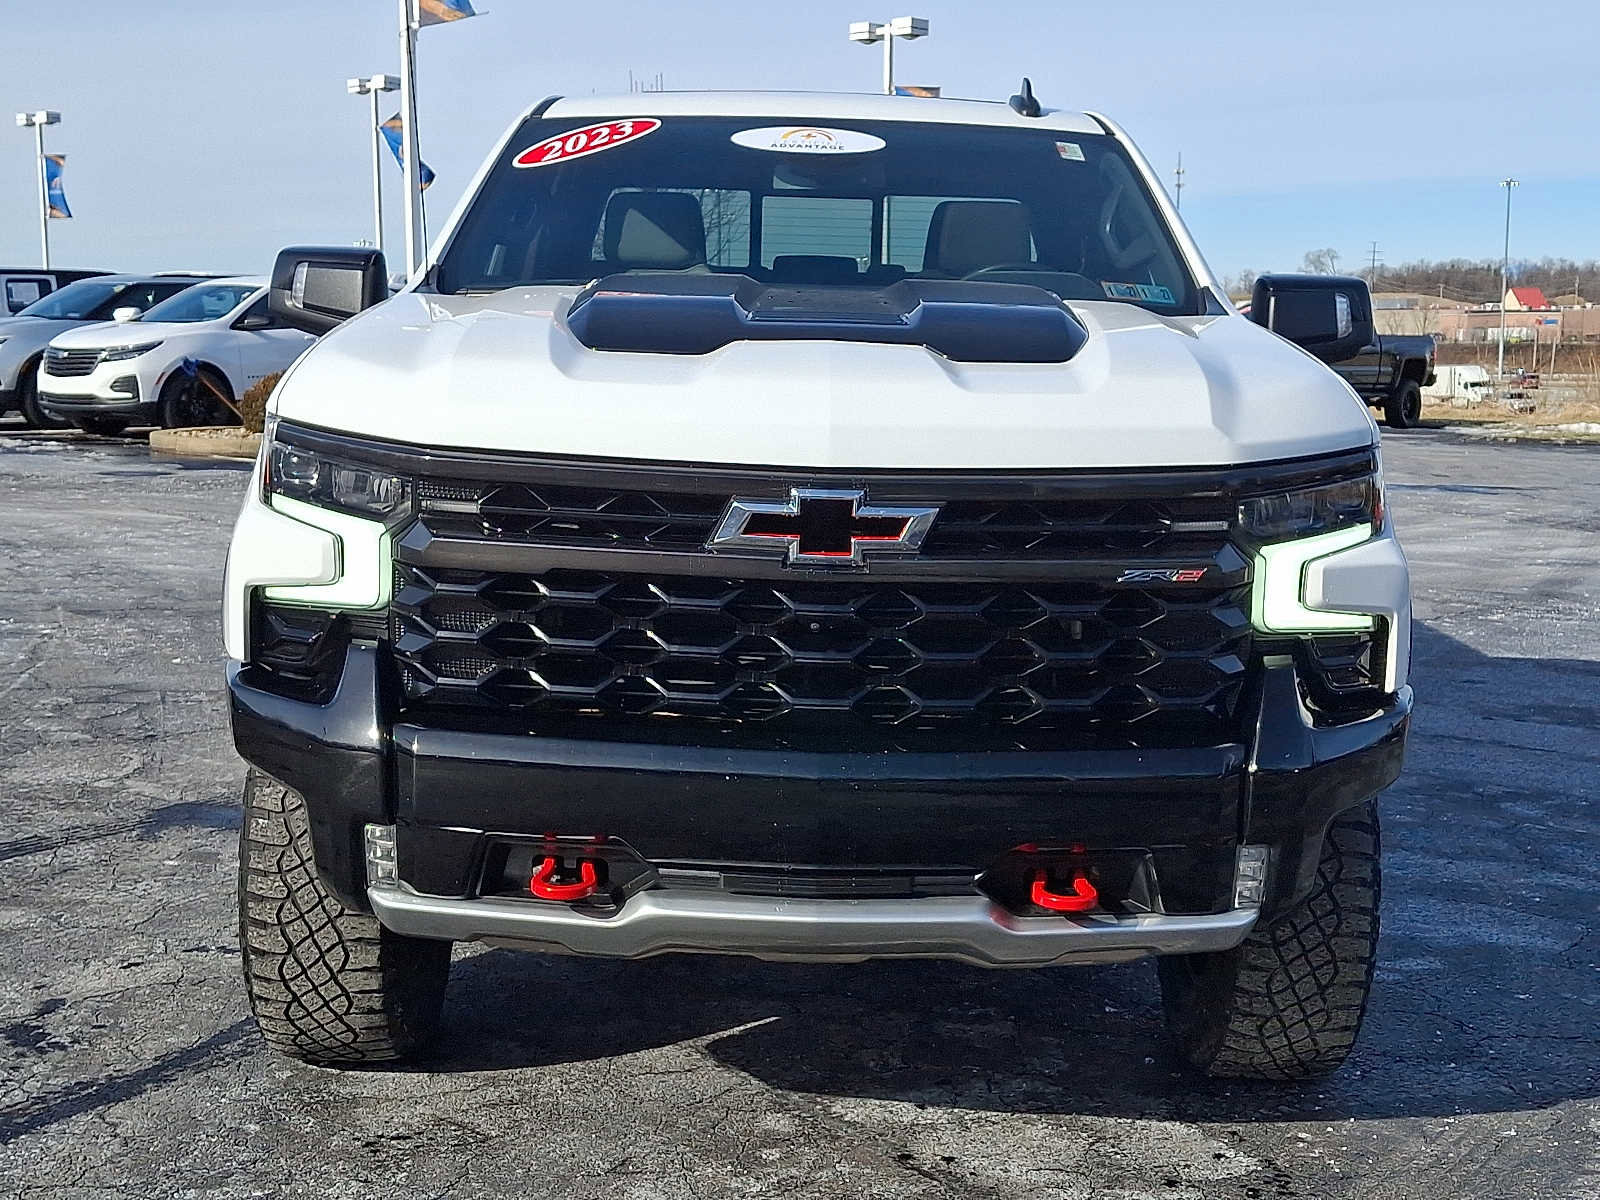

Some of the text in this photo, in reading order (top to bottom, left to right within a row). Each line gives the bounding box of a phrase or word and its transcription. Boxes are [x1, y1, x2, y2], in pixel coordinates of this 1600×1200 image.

[541, 121, 633, 162] 2023
[770, 143, 845, 151] ADVANTAGE
[1118, 567, 1207, 582] ZR2
